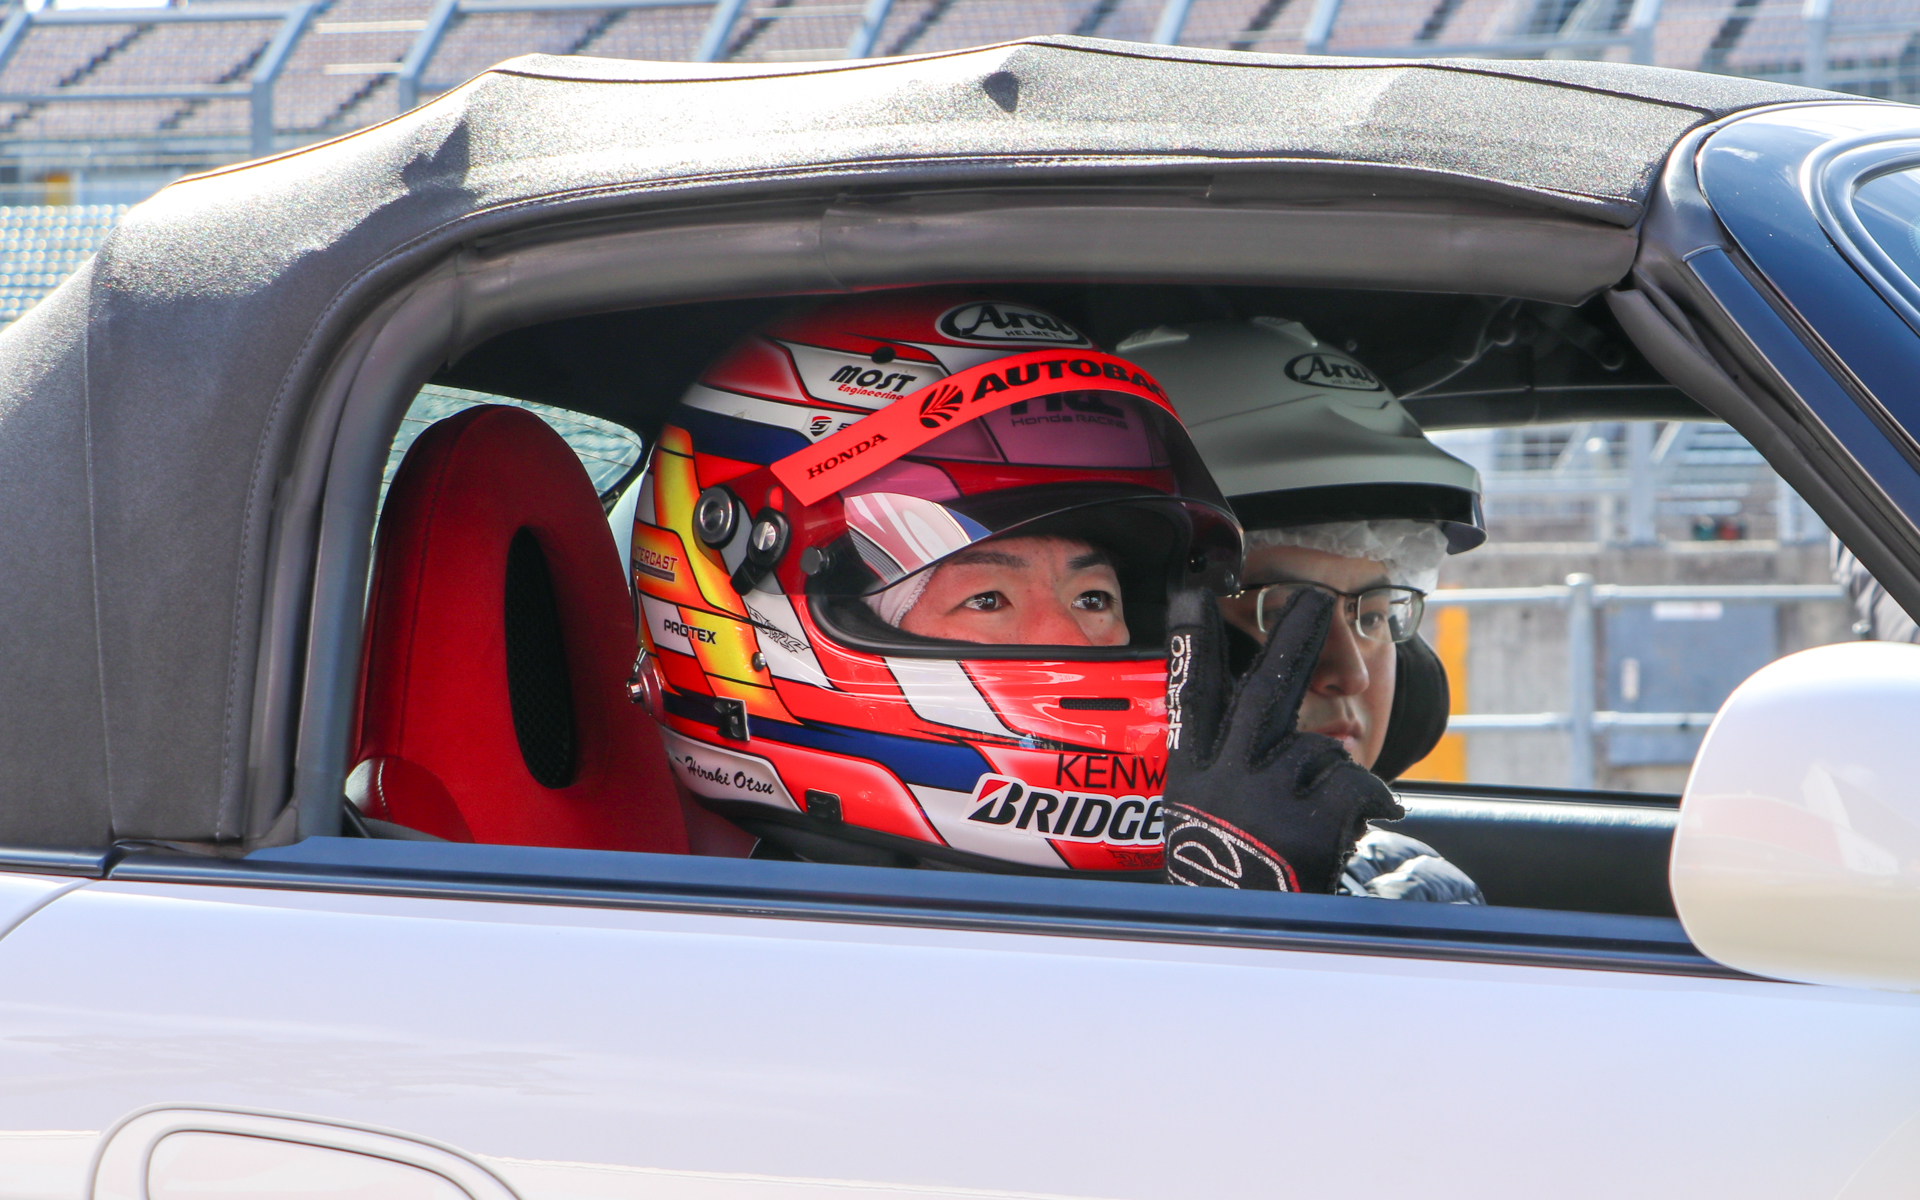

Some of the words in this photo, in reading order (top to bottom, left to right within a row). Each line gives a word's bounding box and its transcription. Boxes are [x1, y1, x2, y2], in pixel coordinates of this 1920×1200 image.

[960, 305, 1073, 336] Arai
[1005, 330, 1059, 338] HELMET
[829, 365, 917, 392] MOST
[1299, 356, 1375, 383] Arai
[838, 384, 904, 402] Engineering
[1011, 414, 1073, 428] Honda
[1076, 414, 1128, 430] RACING
[807, 433, 888, 481] HONDA
[663, 618, 717, 645] PROTEX
[685, 756, 730, 785] Hiroki
[733, 771, 774, 795] Otsu
[1056, 753, 1167, 790] KENW
